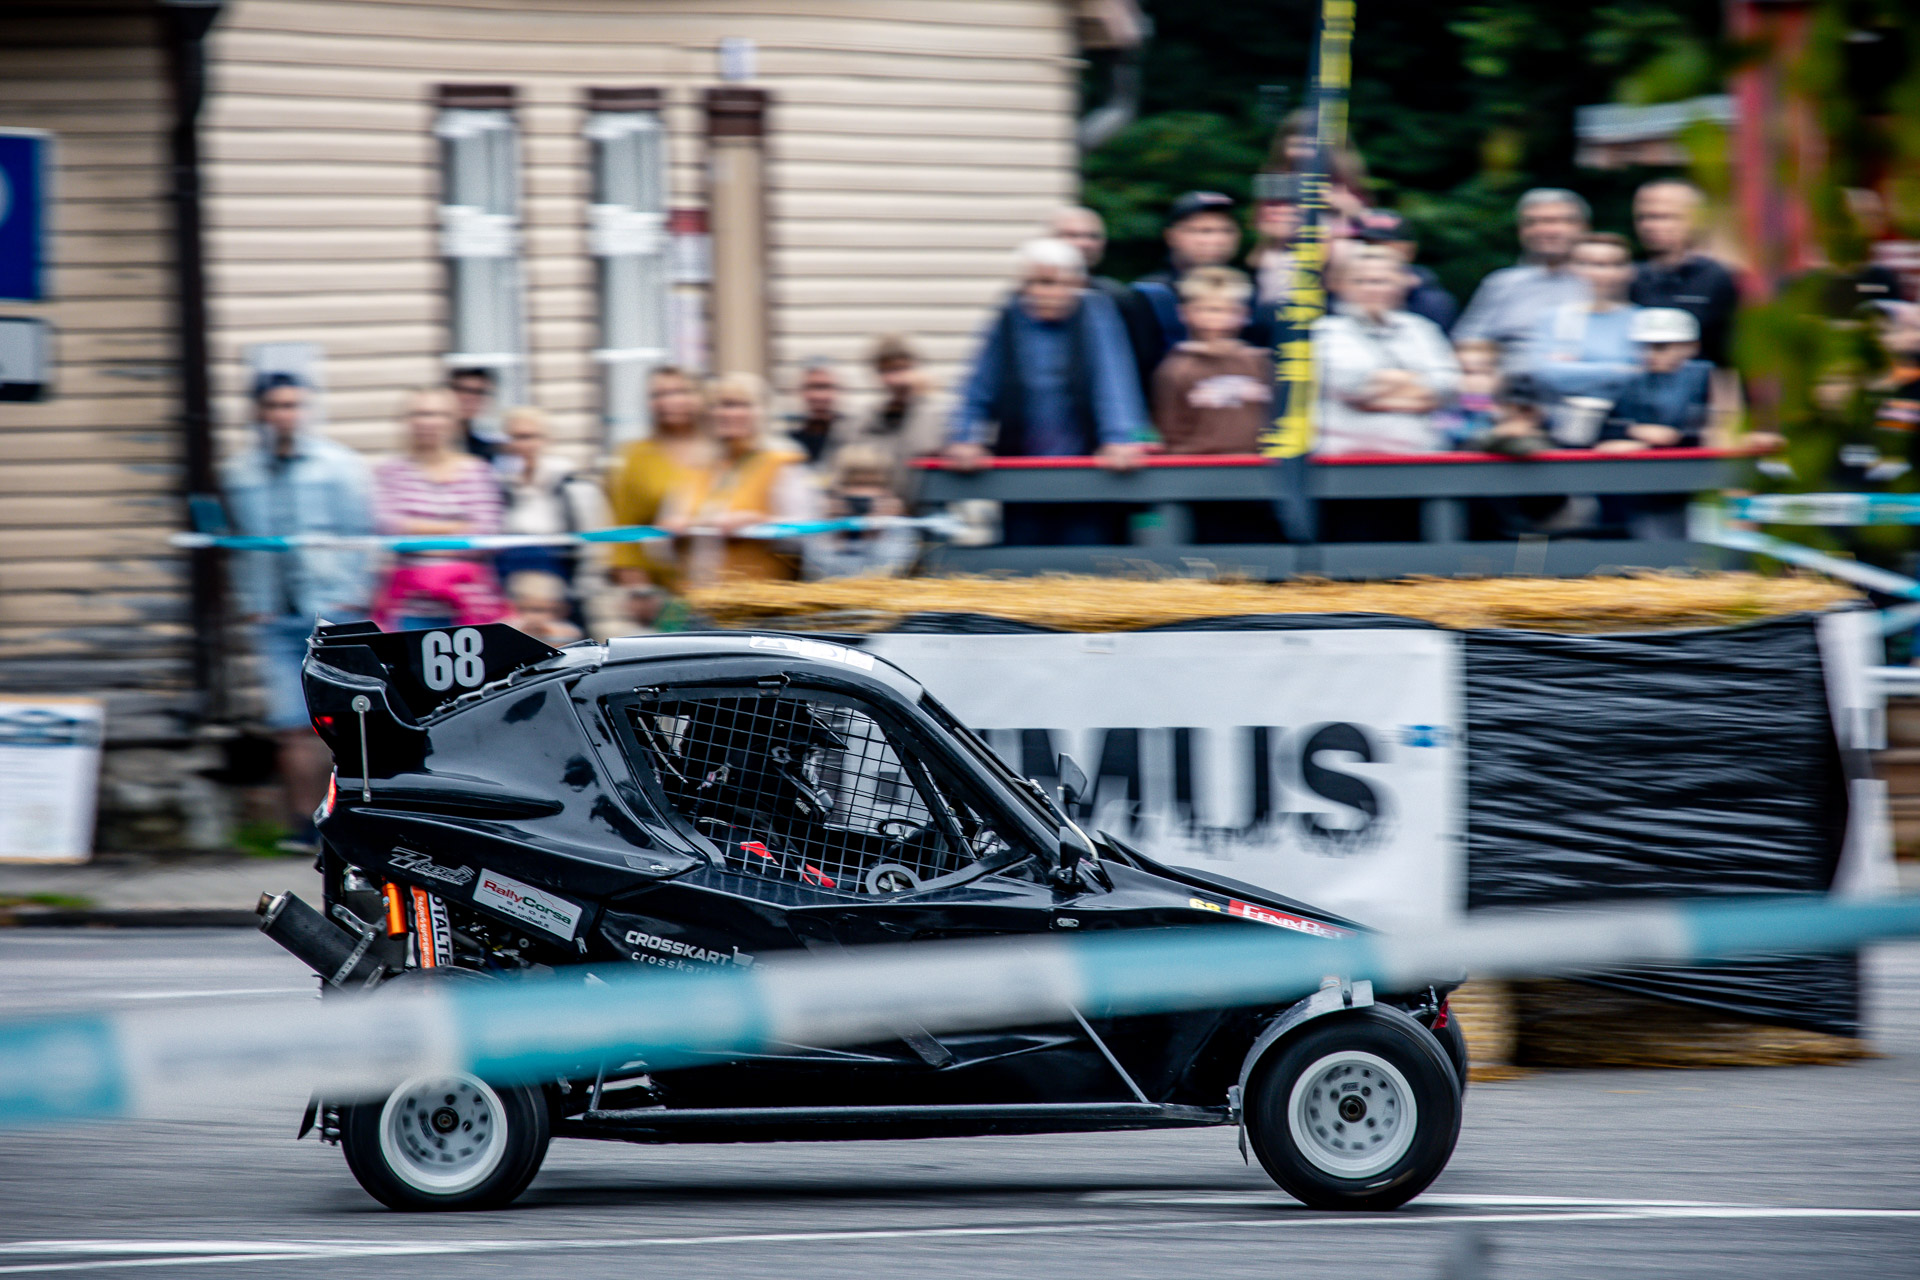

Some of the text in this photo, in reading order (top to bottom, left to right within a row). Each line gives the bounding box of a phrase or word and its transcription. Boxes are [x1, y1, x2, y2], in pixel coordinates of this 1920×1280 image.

[421, 627, 485, 691] 68
[482, 880, 573, 925] RallyCorsa
[506, 900, 547, 920] SHOP
[624, 930, 731, 967] CROSSKART
